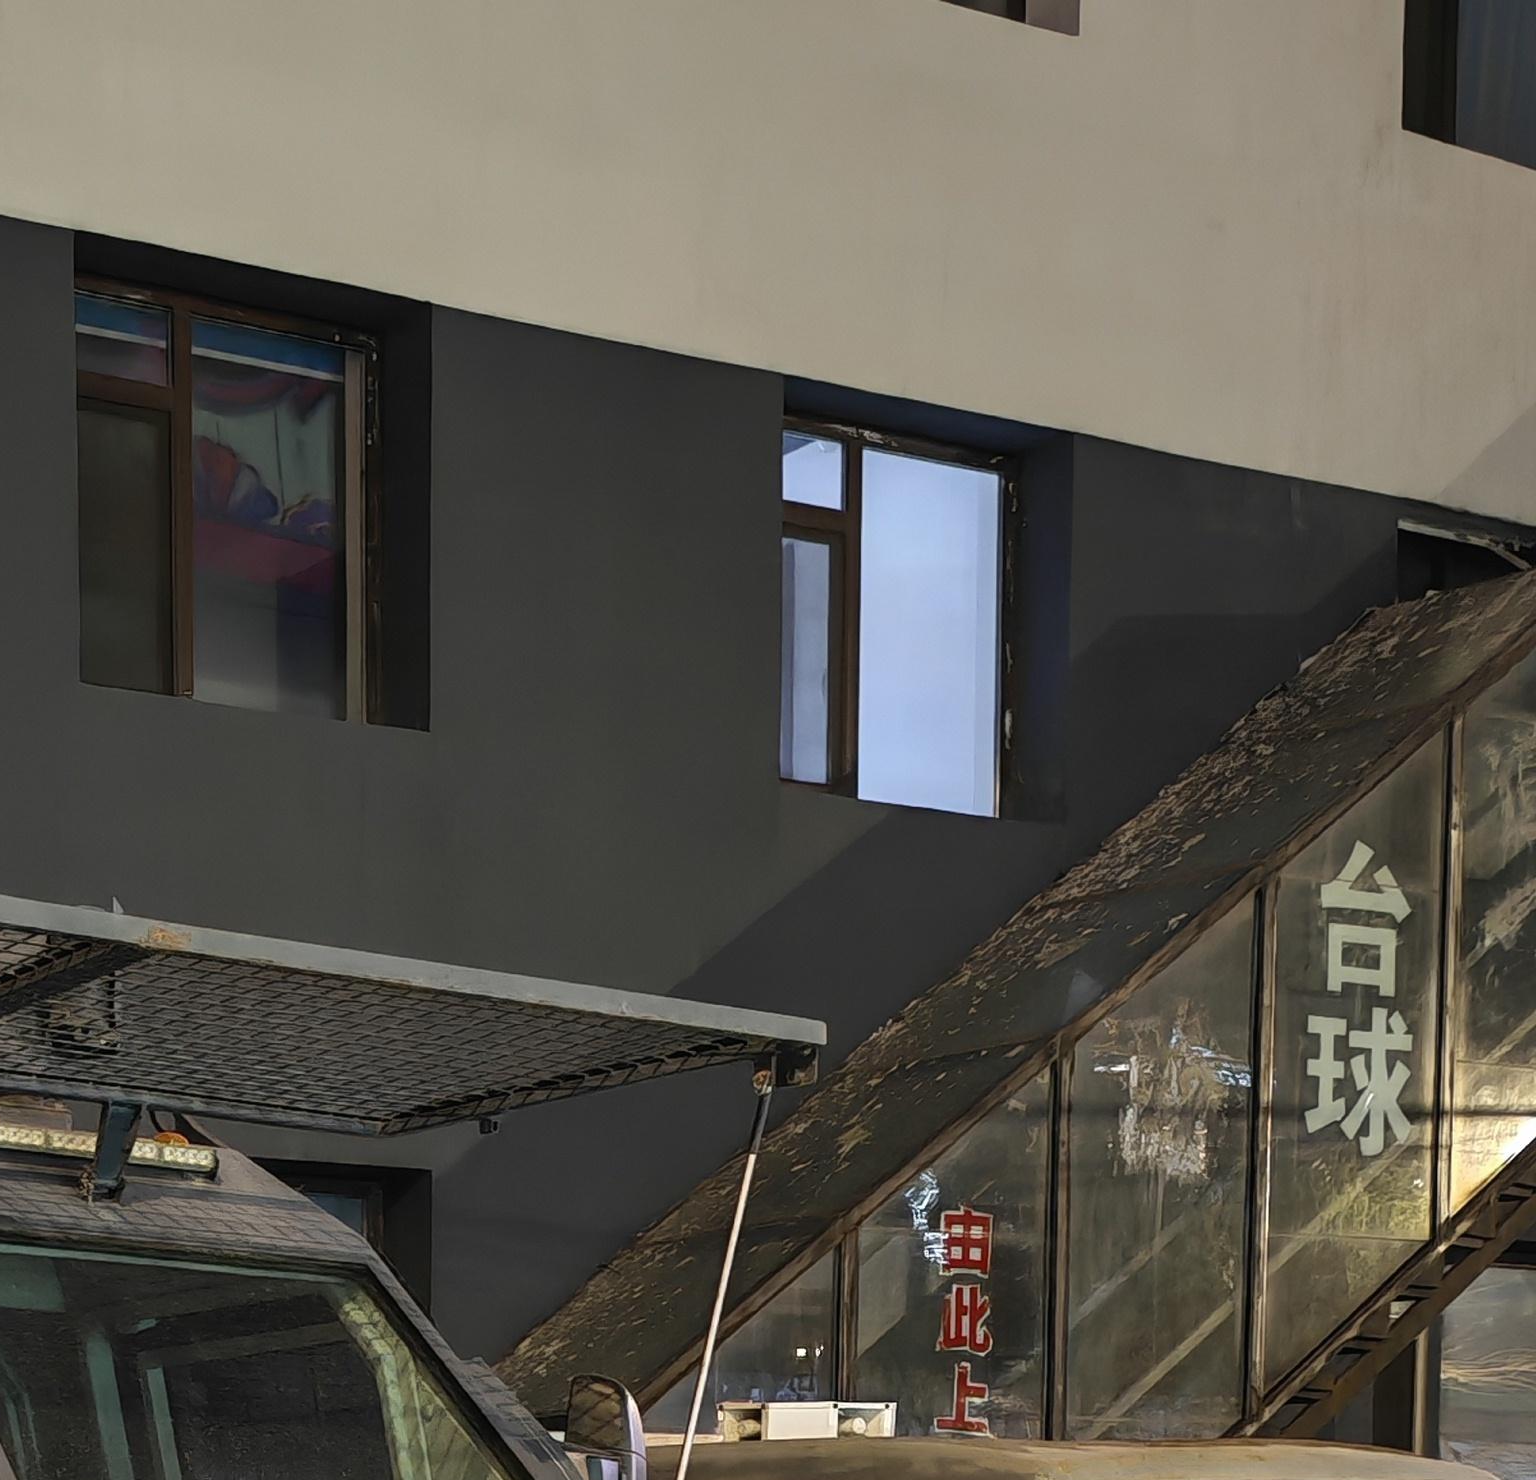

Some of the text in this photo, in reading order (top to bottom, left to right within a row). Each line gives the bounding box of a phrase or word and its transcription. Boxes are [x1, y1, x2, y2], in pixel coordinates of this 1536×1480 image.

[1304, 840, 1413, 1157] 台球
[935, 1204, 993, 1436] 由此上
